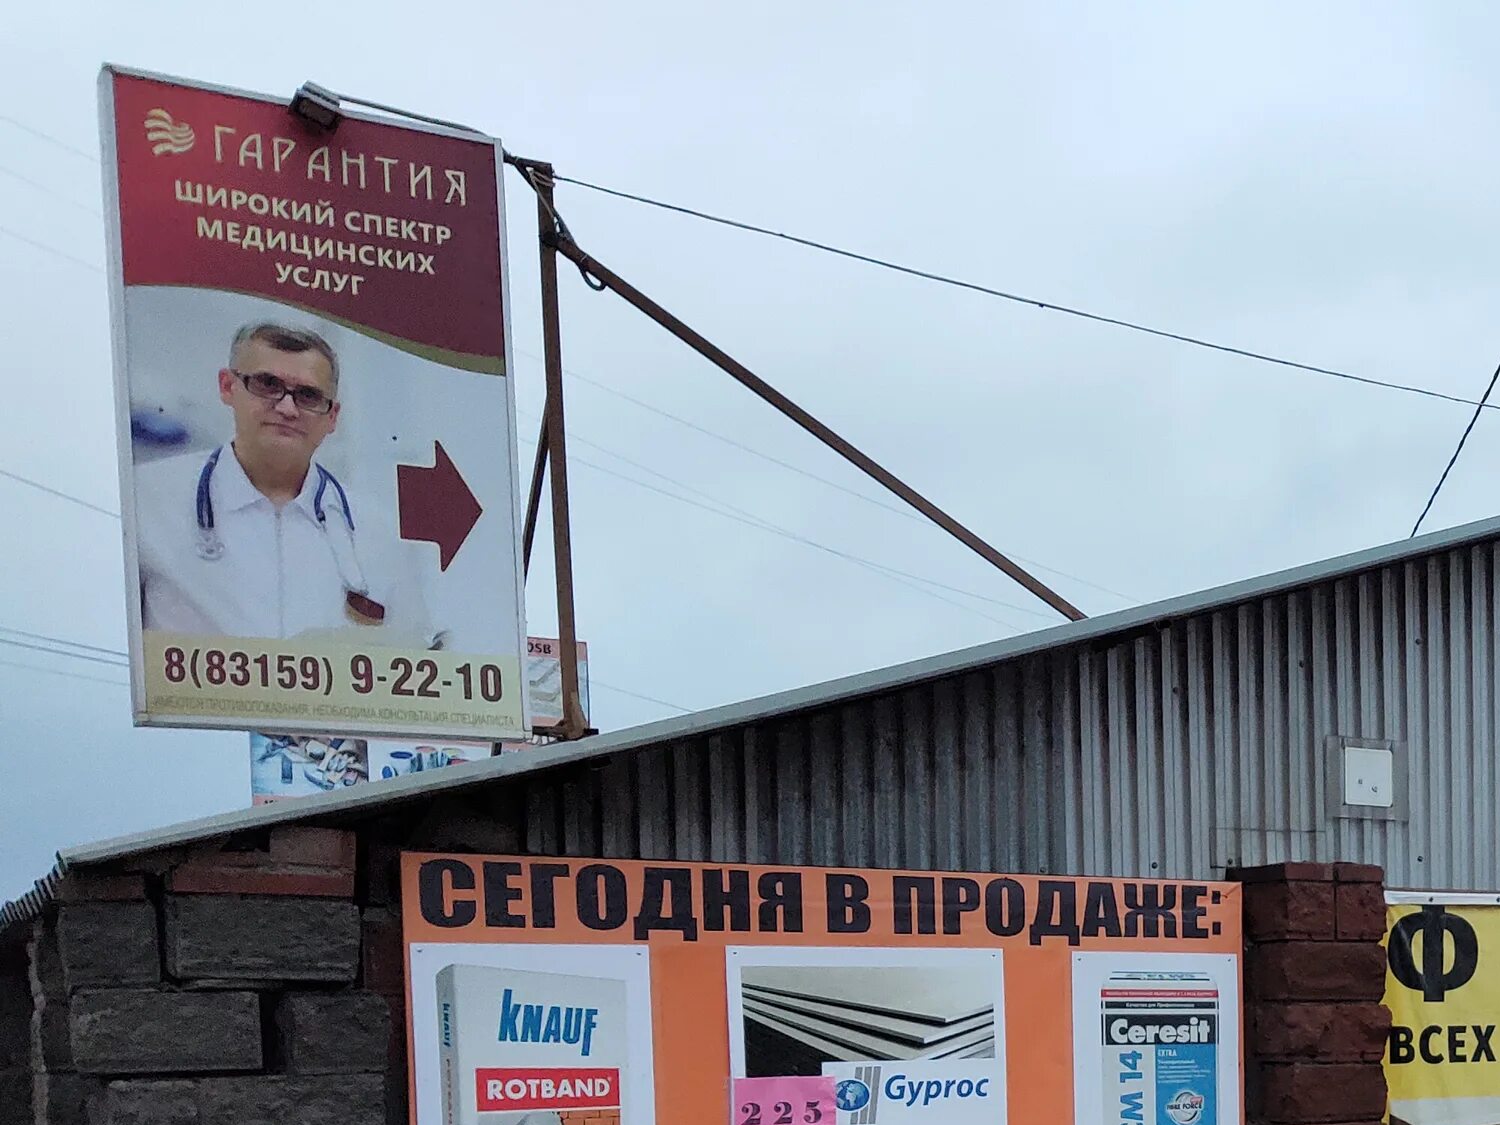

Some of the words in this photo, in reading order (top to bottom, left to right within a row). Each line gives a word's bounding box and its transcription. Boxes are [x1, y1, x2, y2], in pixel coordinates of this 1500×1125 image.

[213, 125, 467, 206] ГАРАНТИЯ
[174, 179, 336, 228] ШИРОКИЙ
[344, 211, 452, 245] СПЕКТР
[196, 216, 436, 275] МЕДИЦИНСКИХ
[275, 261, 365, 295] УСЛУГ
[163, 646, 334, 697] 8(83159)
[350, 653, 503, 703] 9-22-10
[418, 859, 804, 941] СЕГОДНЯ
[826, 873, 871, 933] В
[893, 875, 1222, 946] ПРОДАЖЕ:
[498, 989, 599, 1056] KNAUF
[1110, 1016, 1210, 1044] Ceresit
[1389, 1023, 1496, 1064] ВСЕХ
[486, 1078, 611, 1100] ROTBAND
[884, 1074, 989, 1107] Gyproc
[1119, 1050, 1143, 1083] 14
